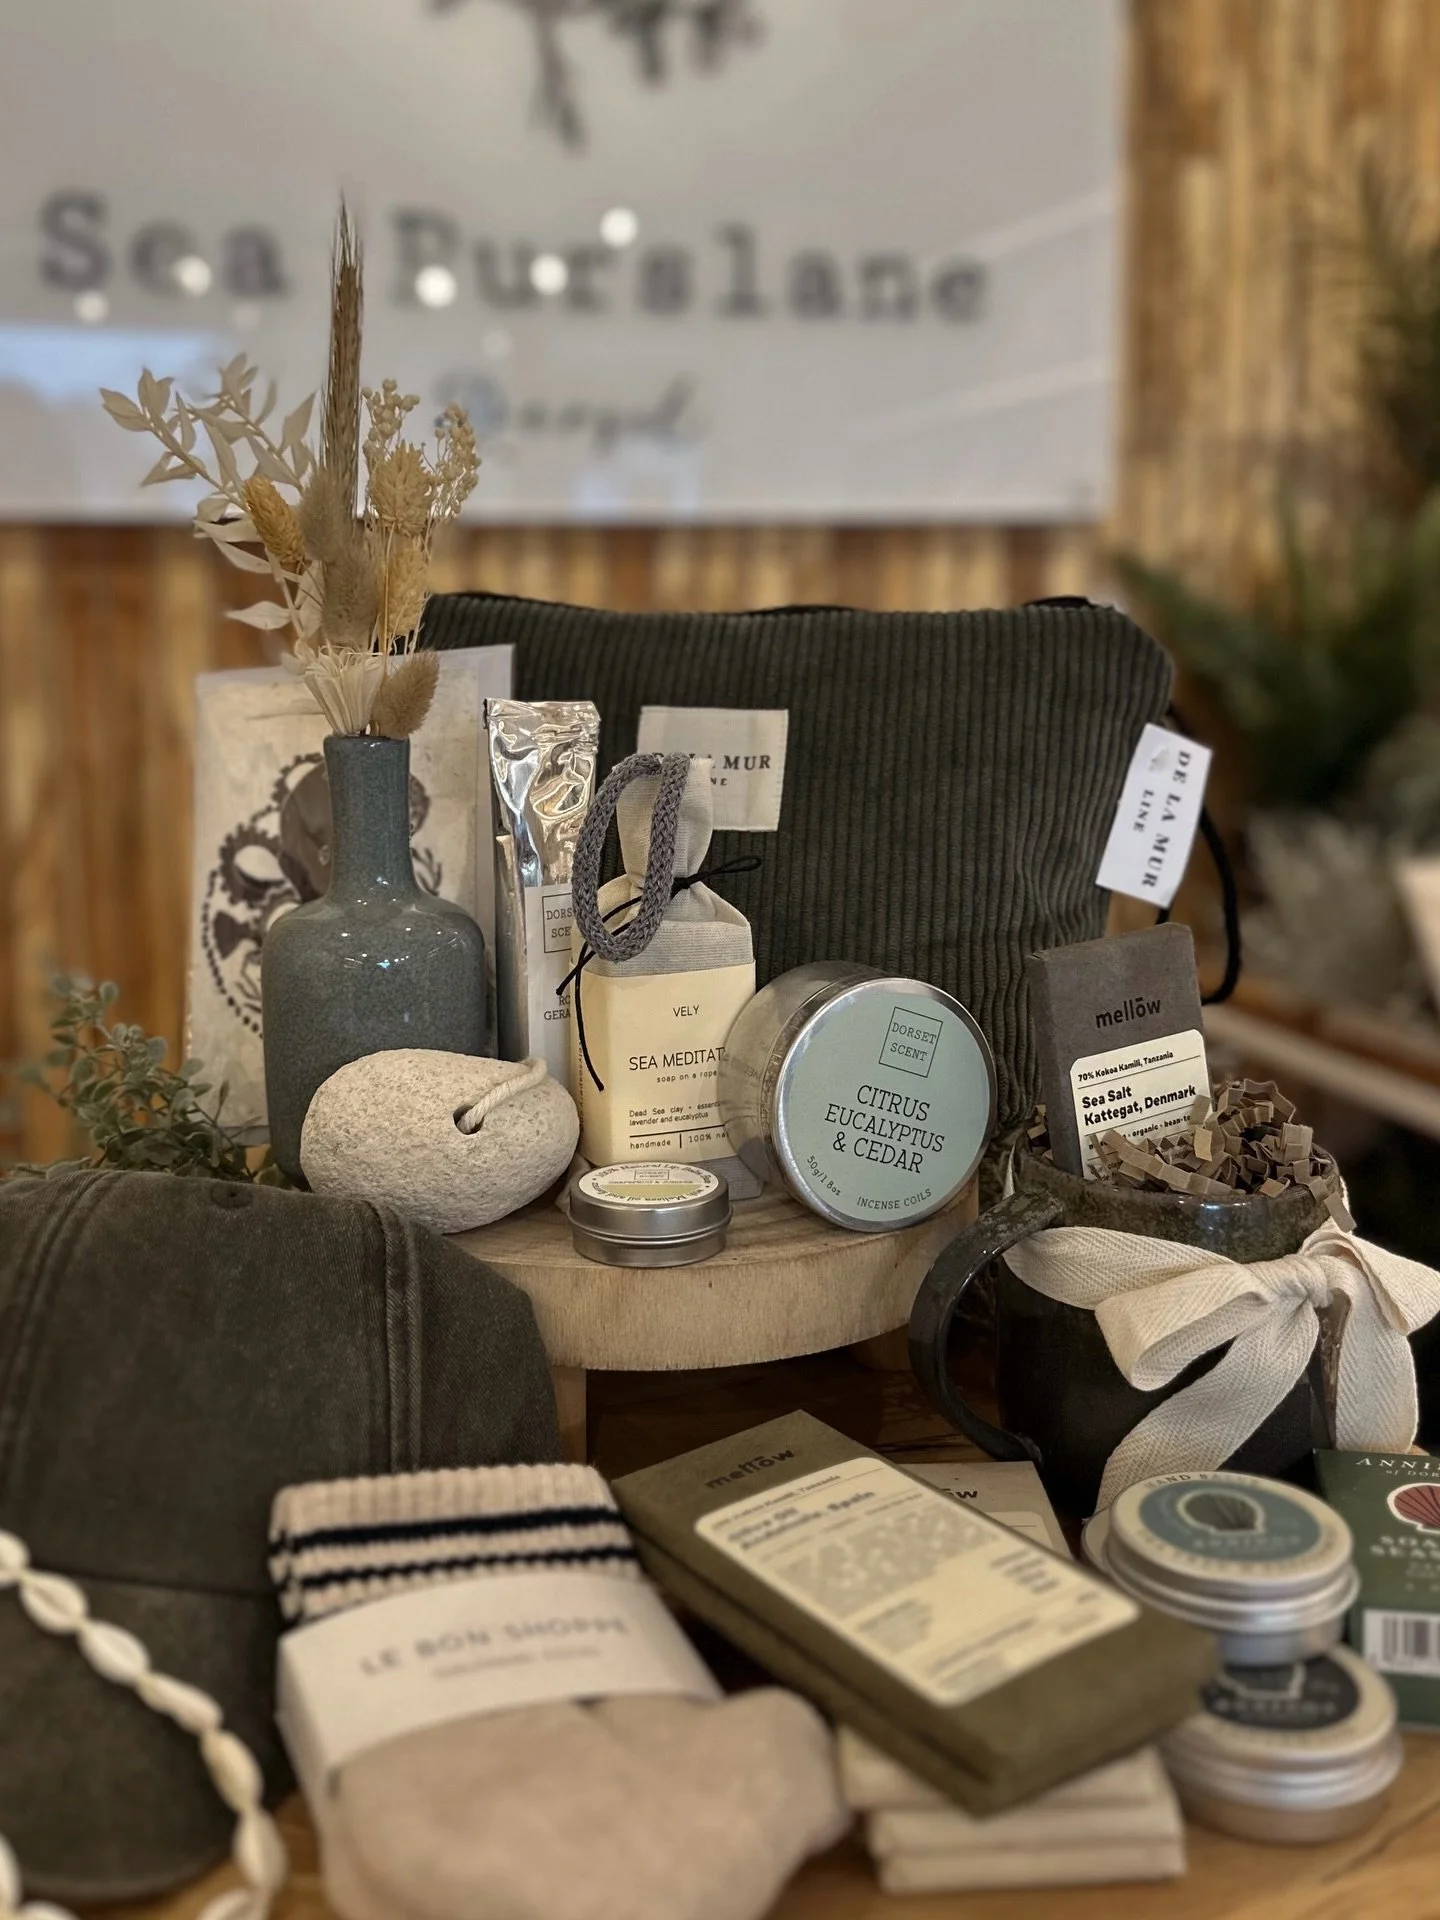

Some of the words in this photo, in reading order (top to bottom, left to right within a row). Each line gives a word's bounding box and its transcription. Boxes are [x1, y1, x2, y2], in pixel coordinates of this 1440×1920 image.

[38, 190, 288, 300] Sea
[388, 204, 992, 326] Purslane
[723, 754, 771, 771] MUR
[1173, 750, 1191, 784] DE
[1134, 789, 1154, 833] LINE
[1162, 794, 1181, 822] LA
[1142, 834, 1170, 888] MUR
[546, 907, 572, 920] DORS
[551, 926, 571, 938] SCE
[544, 1008, 571, 1020] GERA
[673, 1004, 700, 1017] VELY
[891, 1021, 937, 1045] DORSET
[629, 1055, 658, 1071] SEA
[662, 1046, 725, 1069] MEDITAT
[890, 1042, 927, 1062] SCENT
[656, 1074, 676, 1083] soap
[679, 1073, 689, 1081] on
[700, 1069, 718, 1080] rope
[1078, 1071, 1095, 1083] 70%
[1095, 1066, 1118, 1079] Kokoa
[1143, 1050, 1174, 1065] Tanzania
[857, 1084, 930, 1121] CITRUS
[1082, 1093, 1107, 1109] Sea
[1107, 1085, 1133, 1103] Salt
[1084, 1100, 1143, 1127] Kattegat,
[1144, 1084, 1197, 1109] Denmark
[629, 1109, 647, 1117] Dead
[652, 1107, 665, 1115] Sea
[670, 1105, 684, 1114] clay
[629, 1117, 659, 1126] lavender
[660, 1115, 673, 1123] and
[674, 1111, 709, 1122] eucalyptus
[824, 1103, 945, 1152] EUCALYPTUS
[1132, 1123, 1159, 1138] organic
[630, 1139, 671, 1149] handmade
[688, 1133, 711, 1143] 100%
[832, 1131, 847, 1152] &
[853, 1137, 923, 1174] CEDAR
[807, 1155, 841, 1196] 50g/18oz
[857, 1196, 900, 1210] INCENSE
[904, 1188, 932, 1207] COILS
[1356, 1457, 1440, 1470] ANNI
[1407, 1470, 1440, 1478] DOR
[359, 1648, 401, 1677] LE
[413, 1628, 491, 1660] BON
